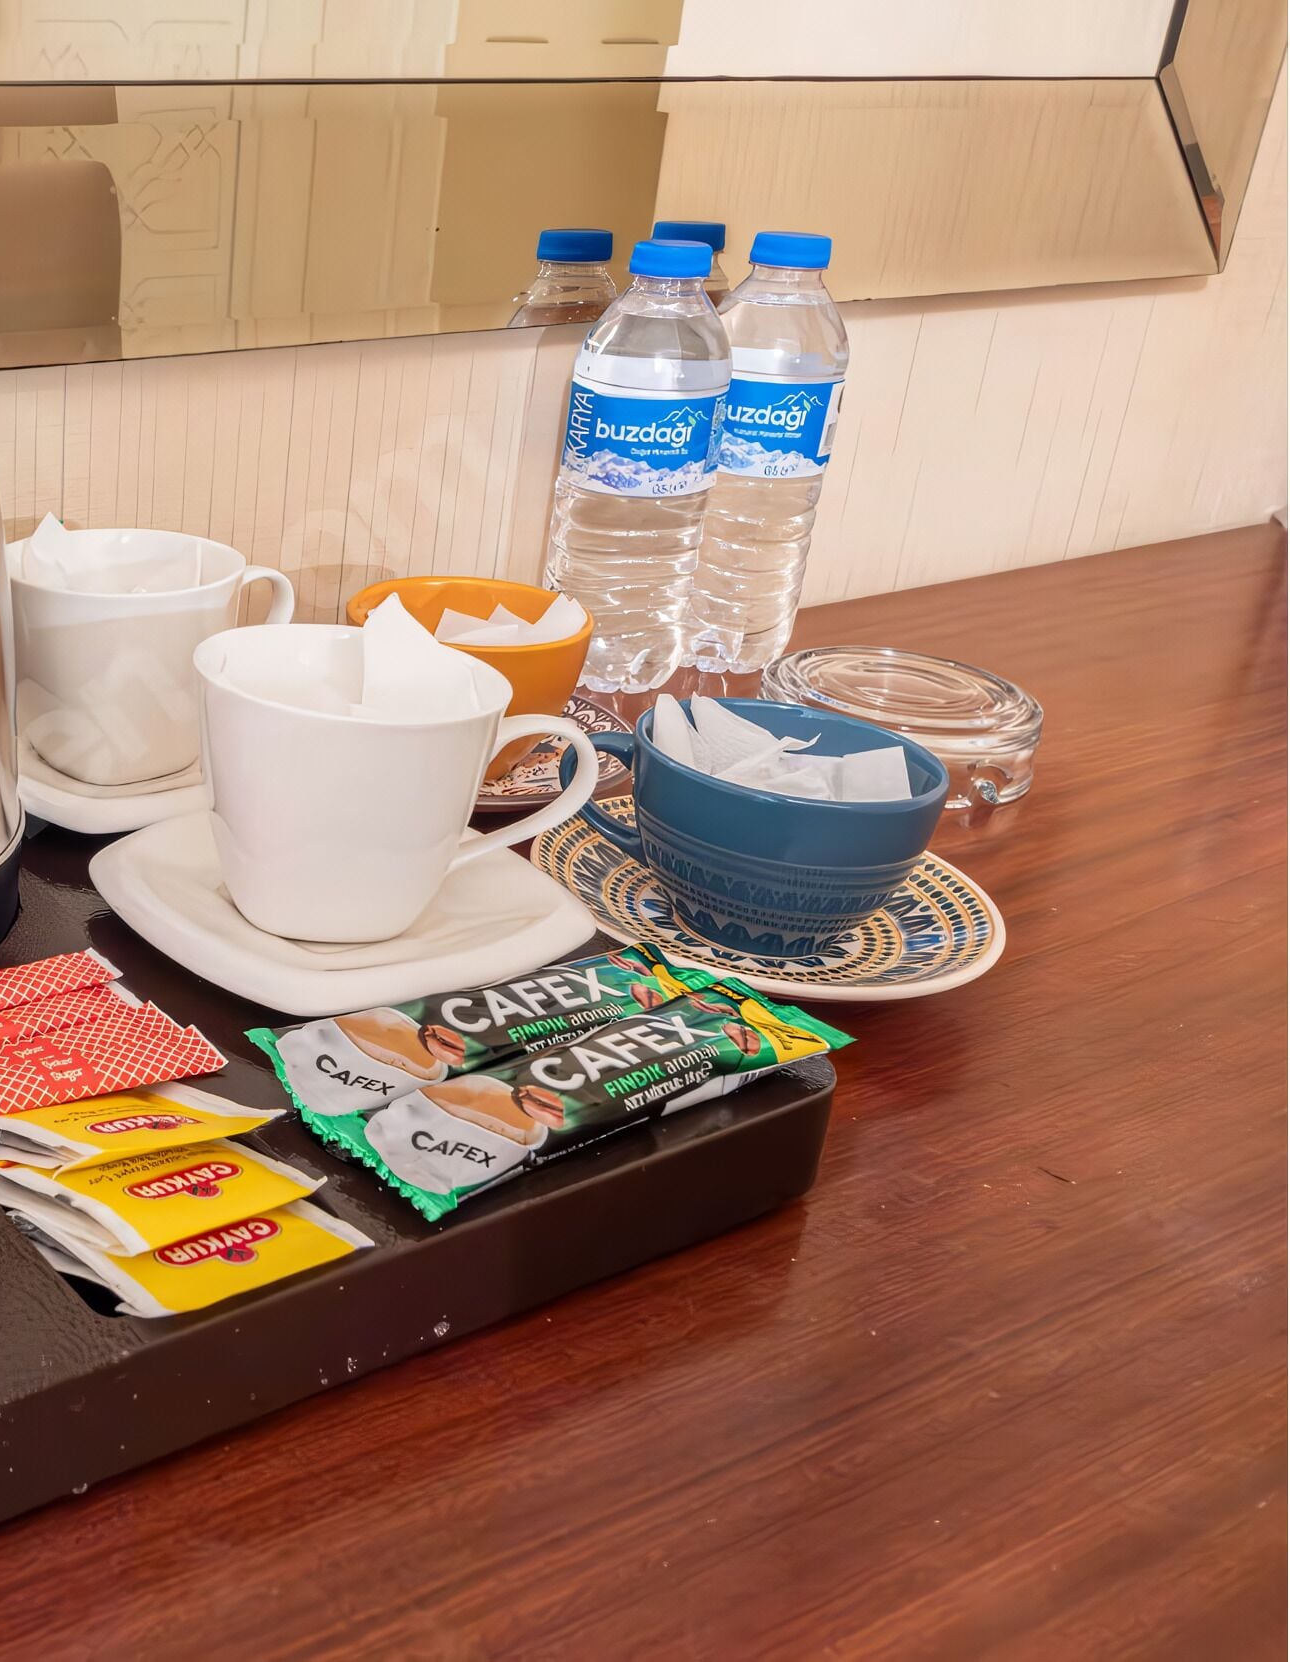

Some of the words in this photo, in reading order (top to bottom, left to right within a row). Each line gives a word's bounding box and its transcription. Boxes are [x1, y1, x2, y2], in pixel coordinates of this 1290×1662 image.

[595, 418, 693, 448] buzdağı
[724, 404, 808, 431] uzdağı
[440, 967, 630, 1032] CAFEX
[507, 1015, 569, 1043] FINDIK
[530, 1014, 724, 1091] CAFEX
[315, 1053, 395, 1096] CAFEX
[604, 1062, 666, 1098] FINDIK
[410, 1130, 497, 1169] CAFEX
